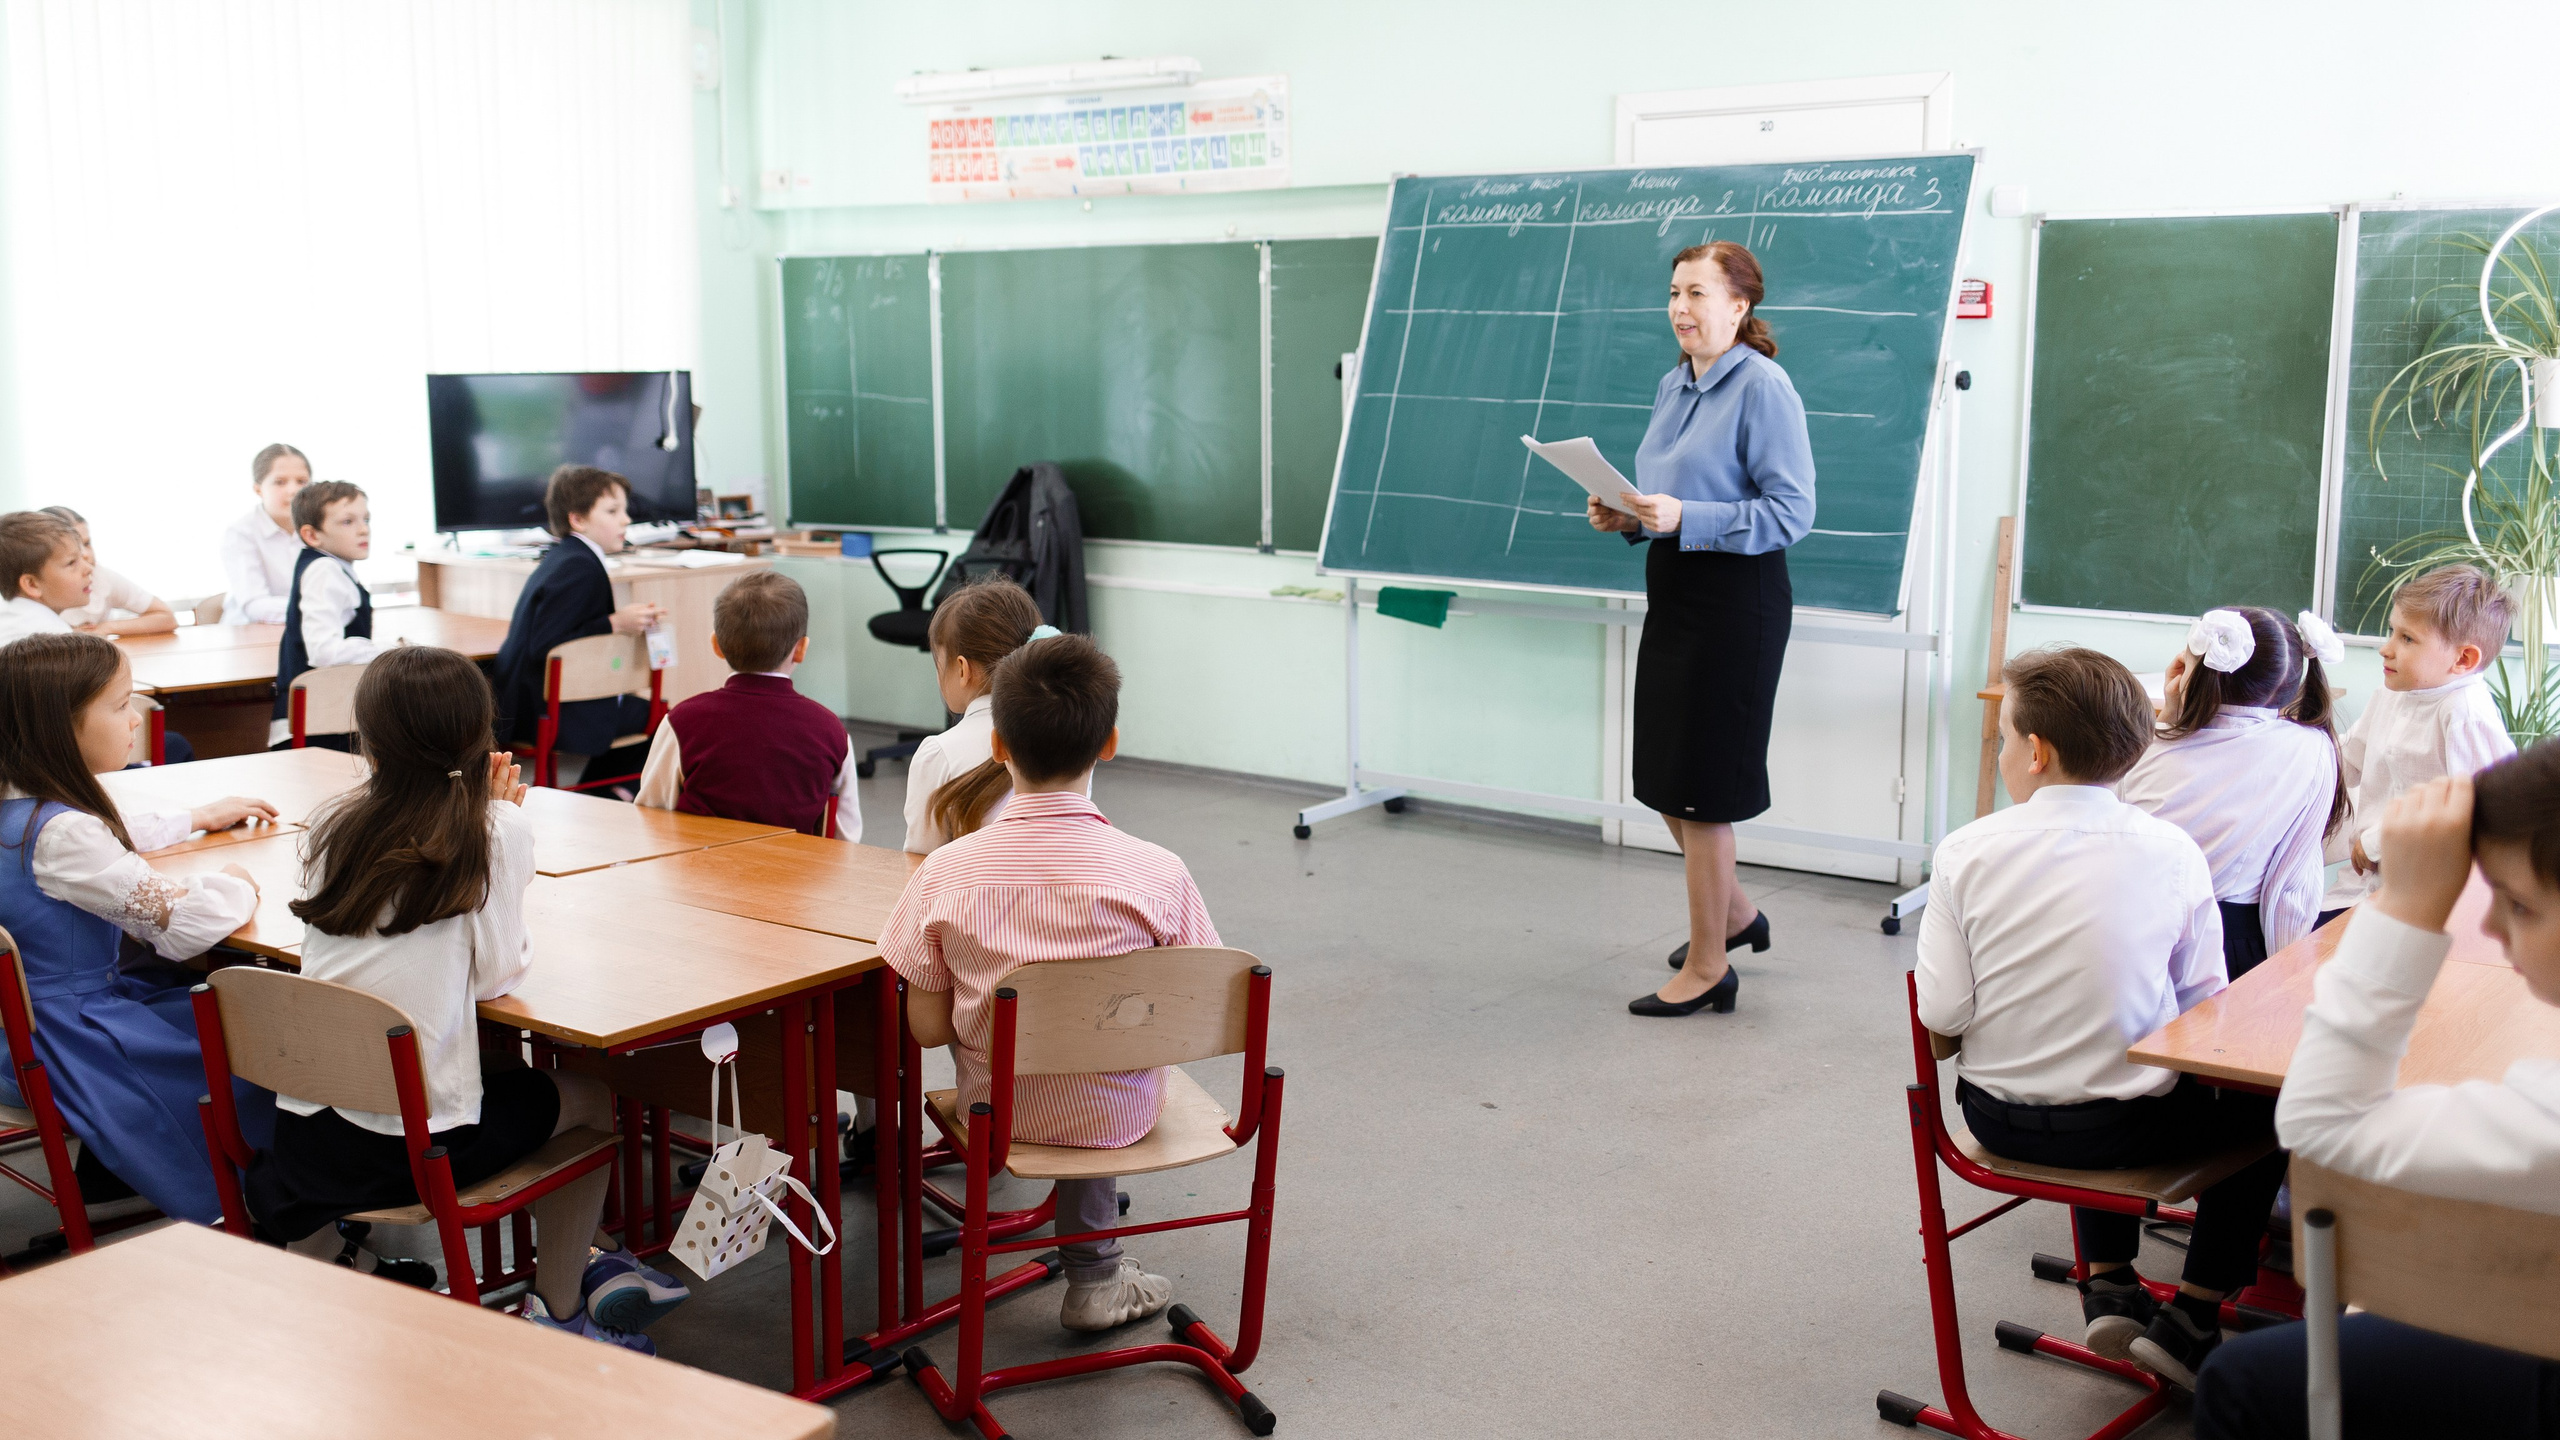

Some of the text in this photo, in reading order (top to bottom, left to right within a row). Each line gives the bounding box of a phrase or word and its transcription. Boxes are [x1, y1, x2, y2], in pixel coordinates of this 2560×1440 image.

[1759, 120, 1775, 132] 20
[1436, 195, 1567, 238] команда 1
[1578, 189, 1737, 238] команда 2
[1760, 177, 1942, 221] команда 3
